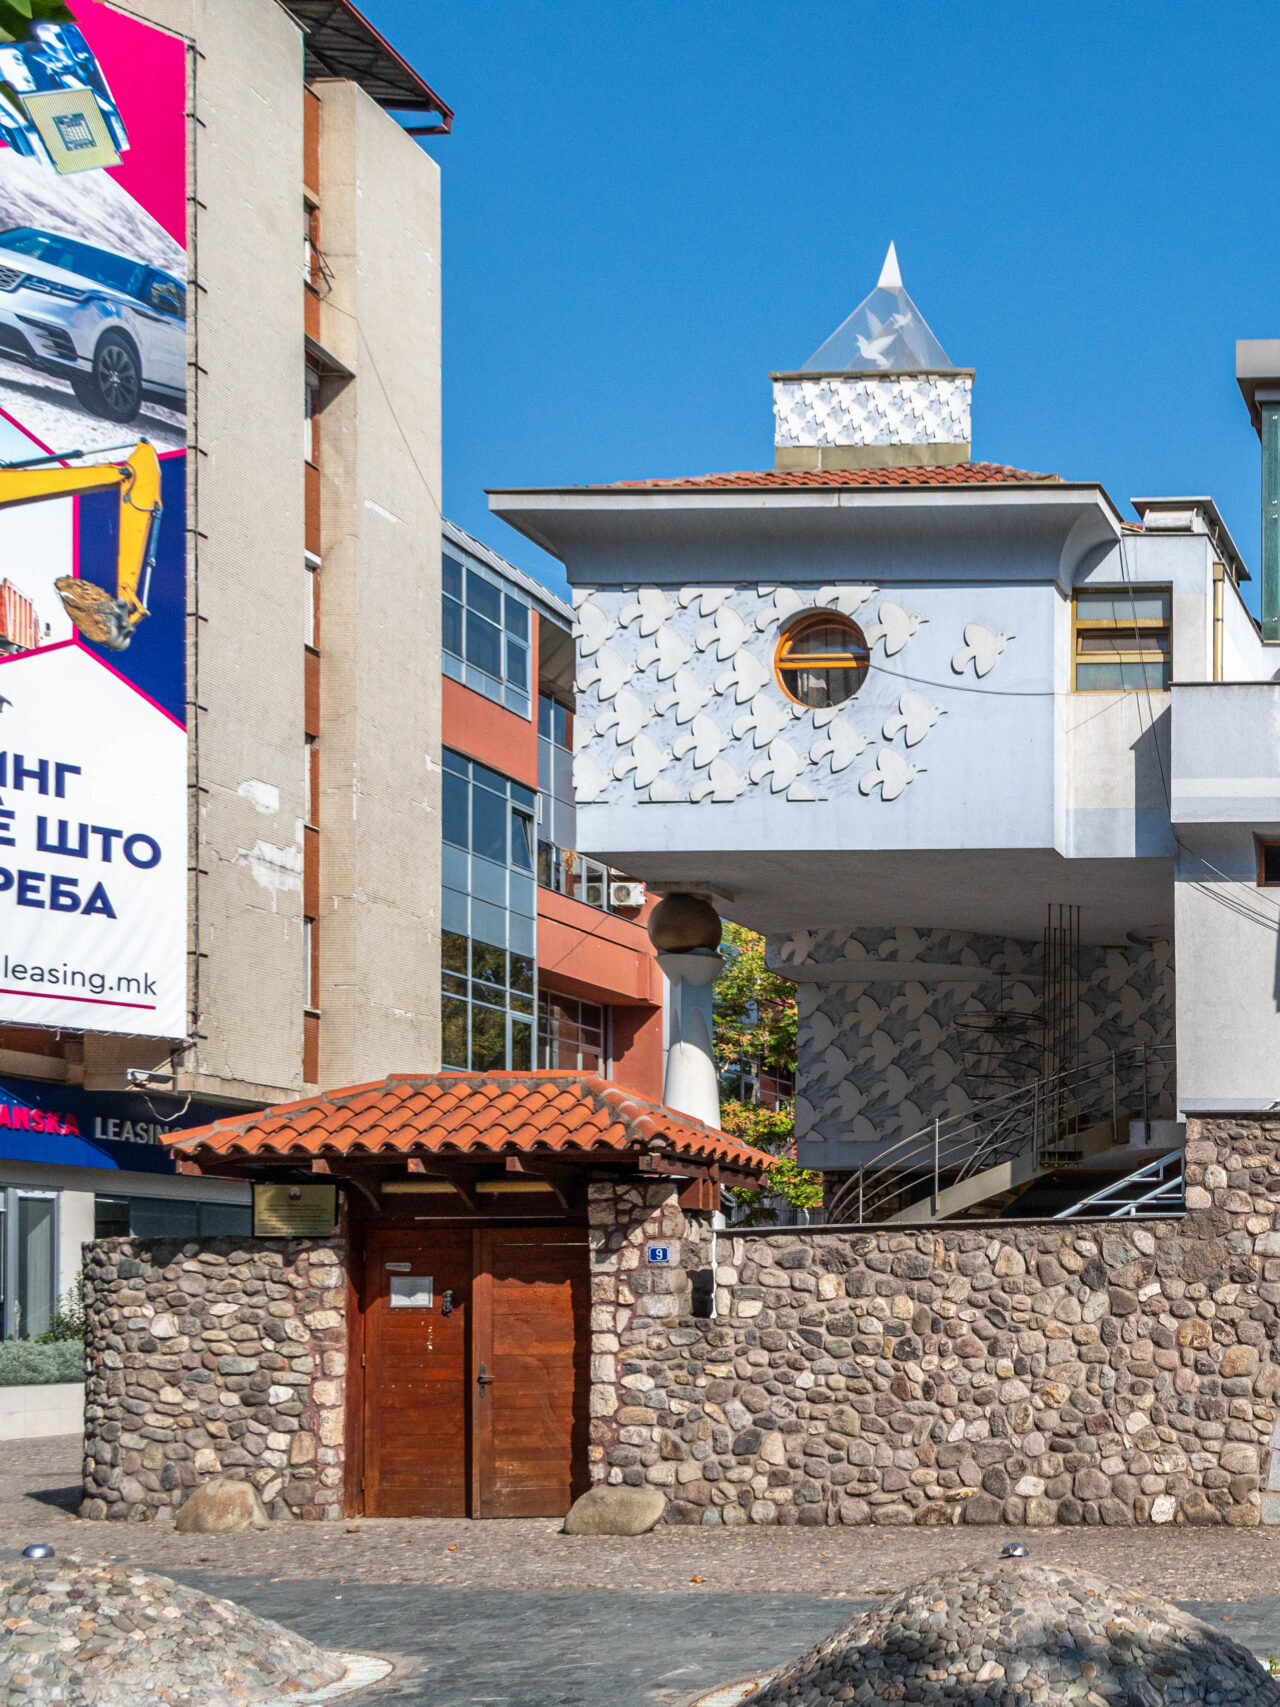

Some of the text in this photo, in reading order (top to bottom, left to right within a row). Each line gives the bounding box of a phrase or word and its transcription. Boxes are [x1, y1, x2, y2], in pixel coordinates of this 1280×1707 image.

[37, 815, 161, 869] ШТО
[4, 955, 157, 995] leasing.mk
[0, 1104, 184, 1146] ANSKA LEASIN
[656, 1249, 663, 1260] 9
